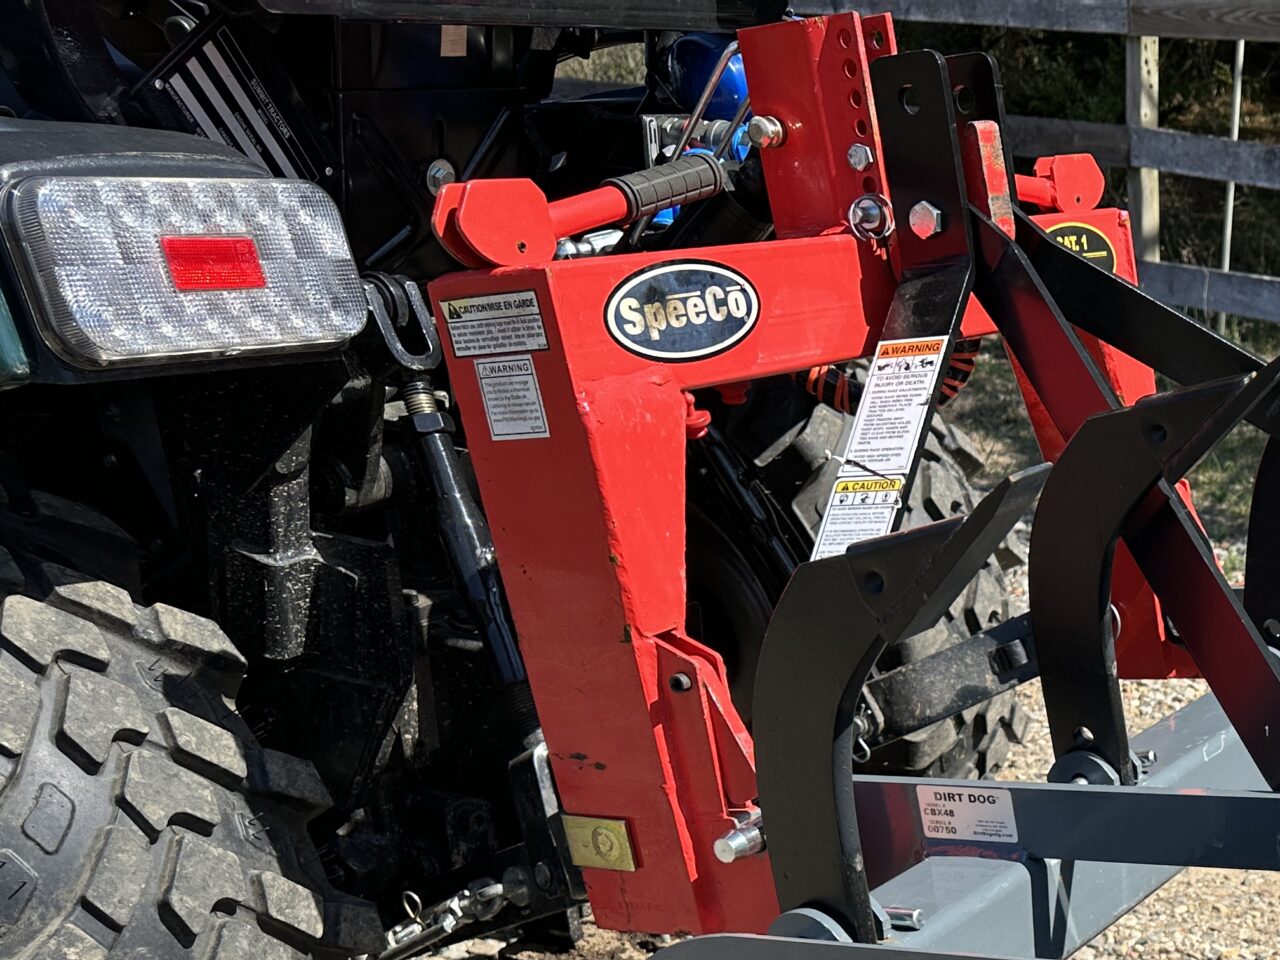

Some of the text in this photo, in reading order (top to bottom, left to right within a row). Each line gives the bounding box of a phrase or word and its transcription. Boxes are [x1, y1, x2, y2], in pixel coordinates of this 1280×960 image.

[251, 78, 291, 139] SUMMIT TRACTORS
[1081, 234, 1088, 251] 1
[513, 299, 535, 309] GARDE
[891, 343, 940, 355] WARNING
[489, 363, 529, 374] WARNING
[852, 481, 896, 491] CAUTION
[934, 792, 997, 805] DIRT DOG
[923, 808, 955, 817] CBX48
